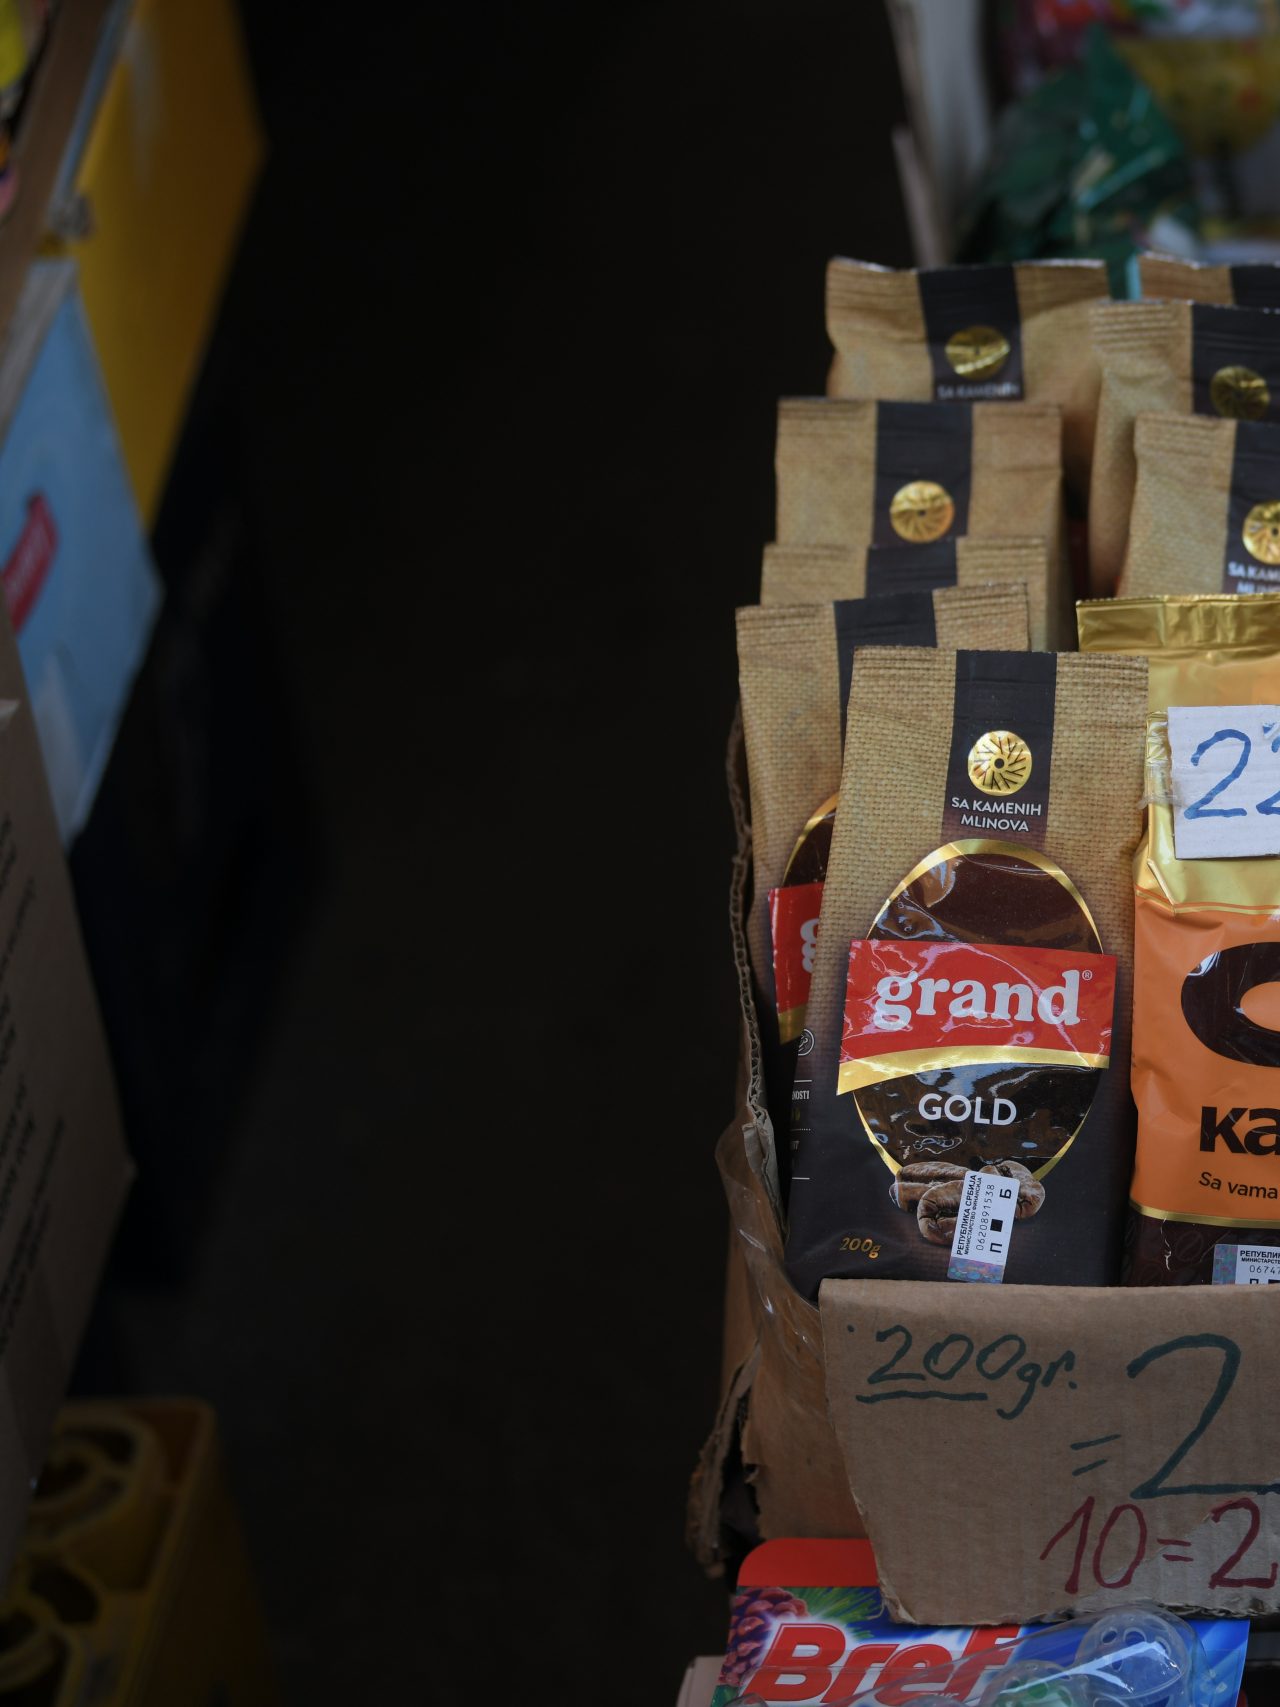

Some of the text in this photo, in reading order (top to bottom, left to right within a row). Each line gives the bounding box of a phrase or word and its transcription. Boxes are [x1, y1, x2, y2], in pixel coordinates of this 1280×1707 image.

[951, 796, 1042, 816] SA KAMENIH
[960, 813, 1030, 832] MLINOVA
[874, 969, 1081, 1031] grand
[918, 1093, 1018, 1126] GOLD
[1198, 1171, 1222, 1190] Sa
[1227, 1181, 1278, 1200] vama
[956, 1174, 977, 1256] РЕПУБЛИКА СРБИЈА
[976, 1183, 995, 1251] 0620891538
[839, 1237, 881, 1259] 200g
[867, 1325, 1078, 1420] 200gr.
